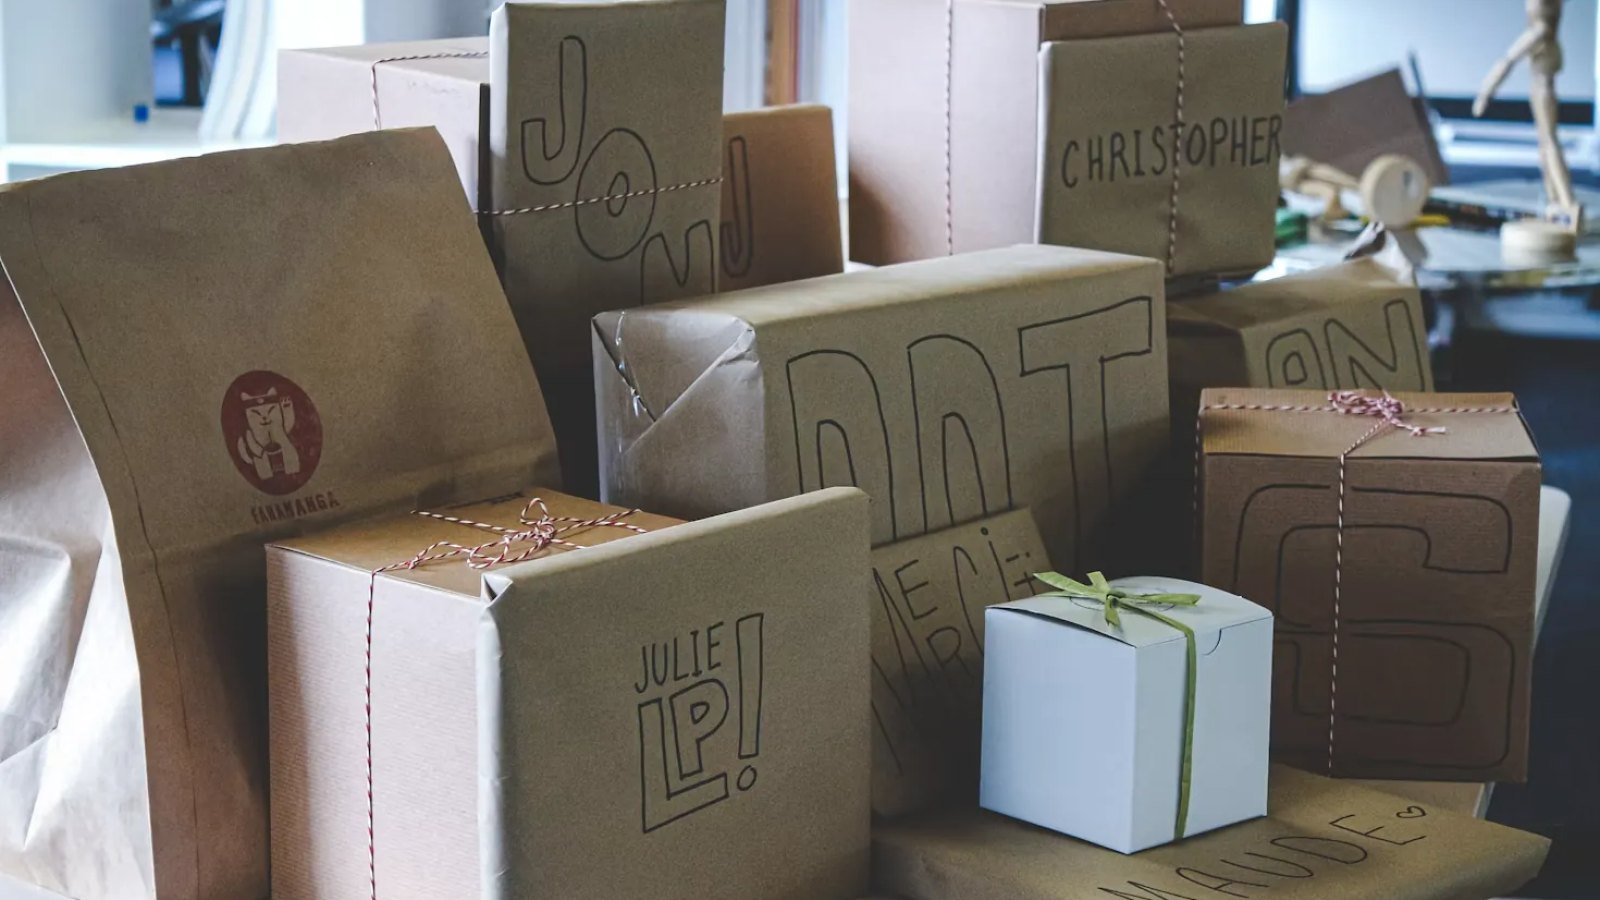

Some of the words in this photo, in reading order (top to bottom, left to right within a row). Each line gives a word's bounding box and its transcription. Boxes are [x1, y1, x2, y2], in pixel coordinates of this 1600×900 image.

[1061, 114, 1283, 188] CHRISTOPHER
[634, 620, 725, 694] JULIE
[637, 612, 764, 834] LP!
